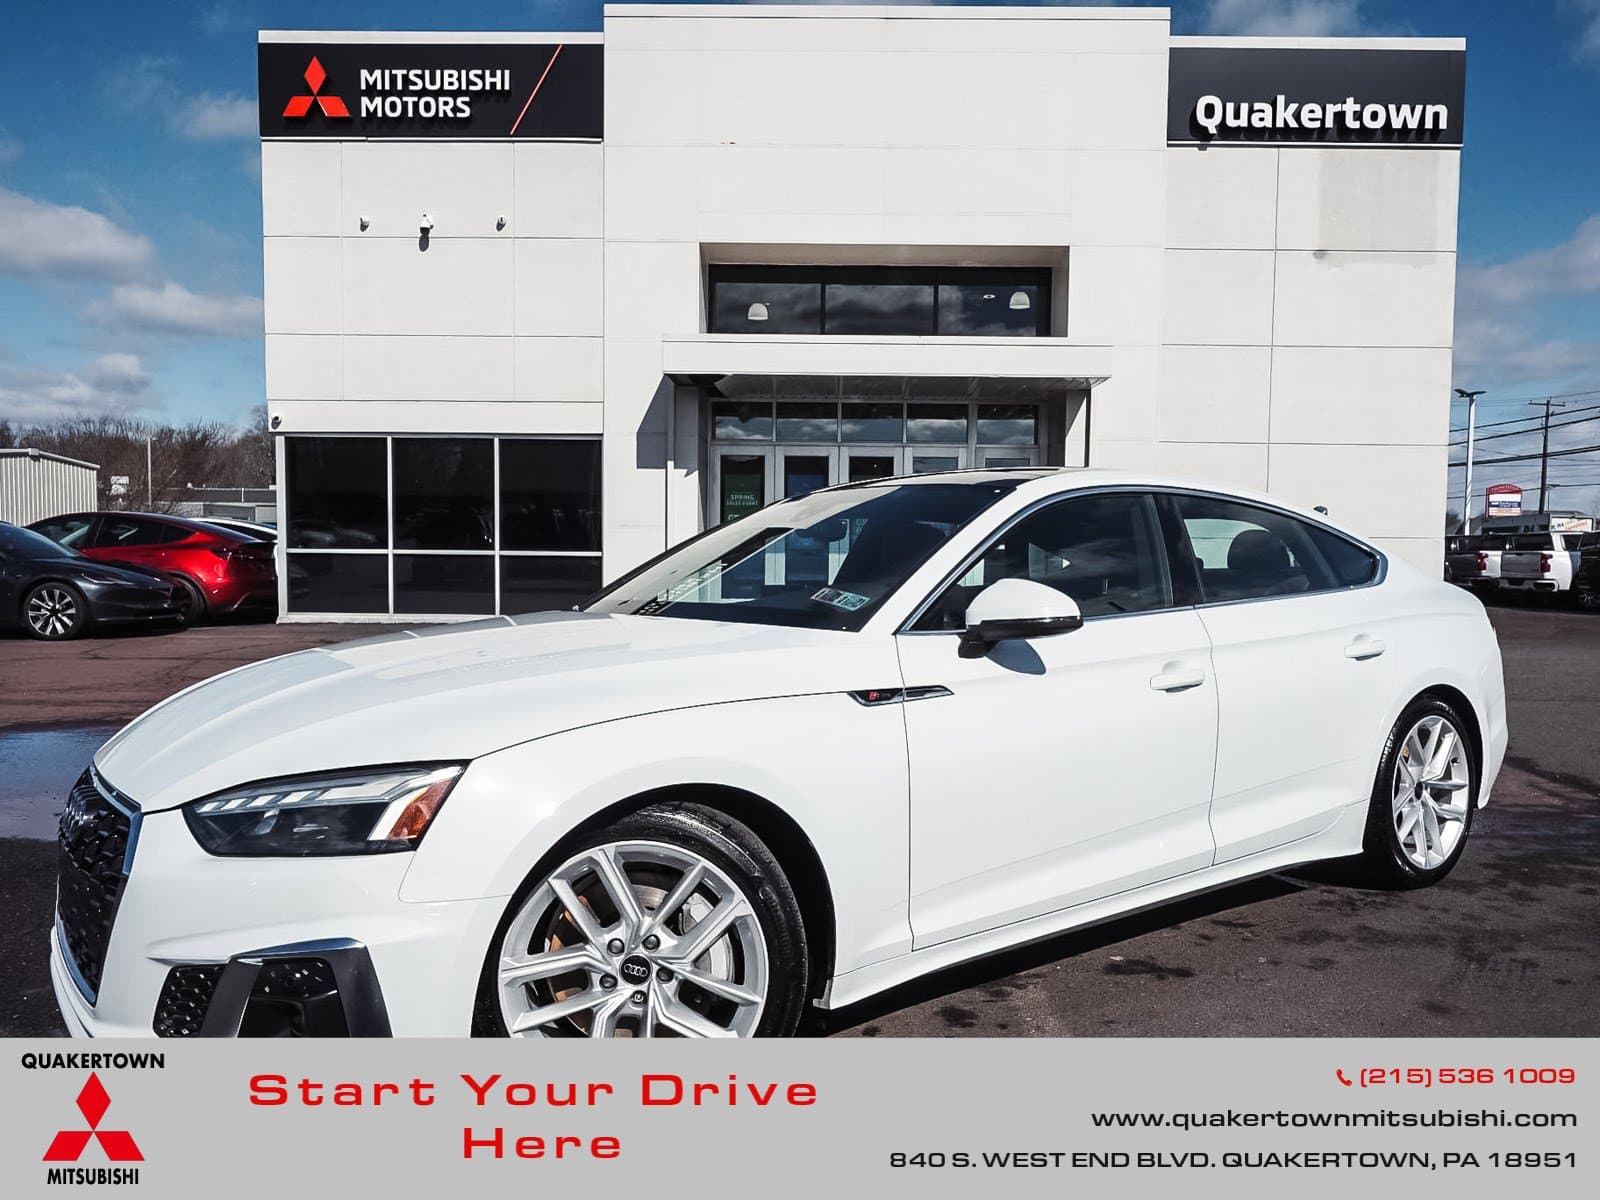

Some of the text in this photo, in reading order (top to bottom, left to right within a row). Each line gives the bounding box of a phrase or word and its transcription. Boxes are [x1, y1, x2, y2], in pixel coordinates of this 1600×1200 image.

[360, 68, 510, 91] MITSUBISHI
[360, 96, 471, 118] MOTORS
[1195, 94, 1449, 135] Quakertown
